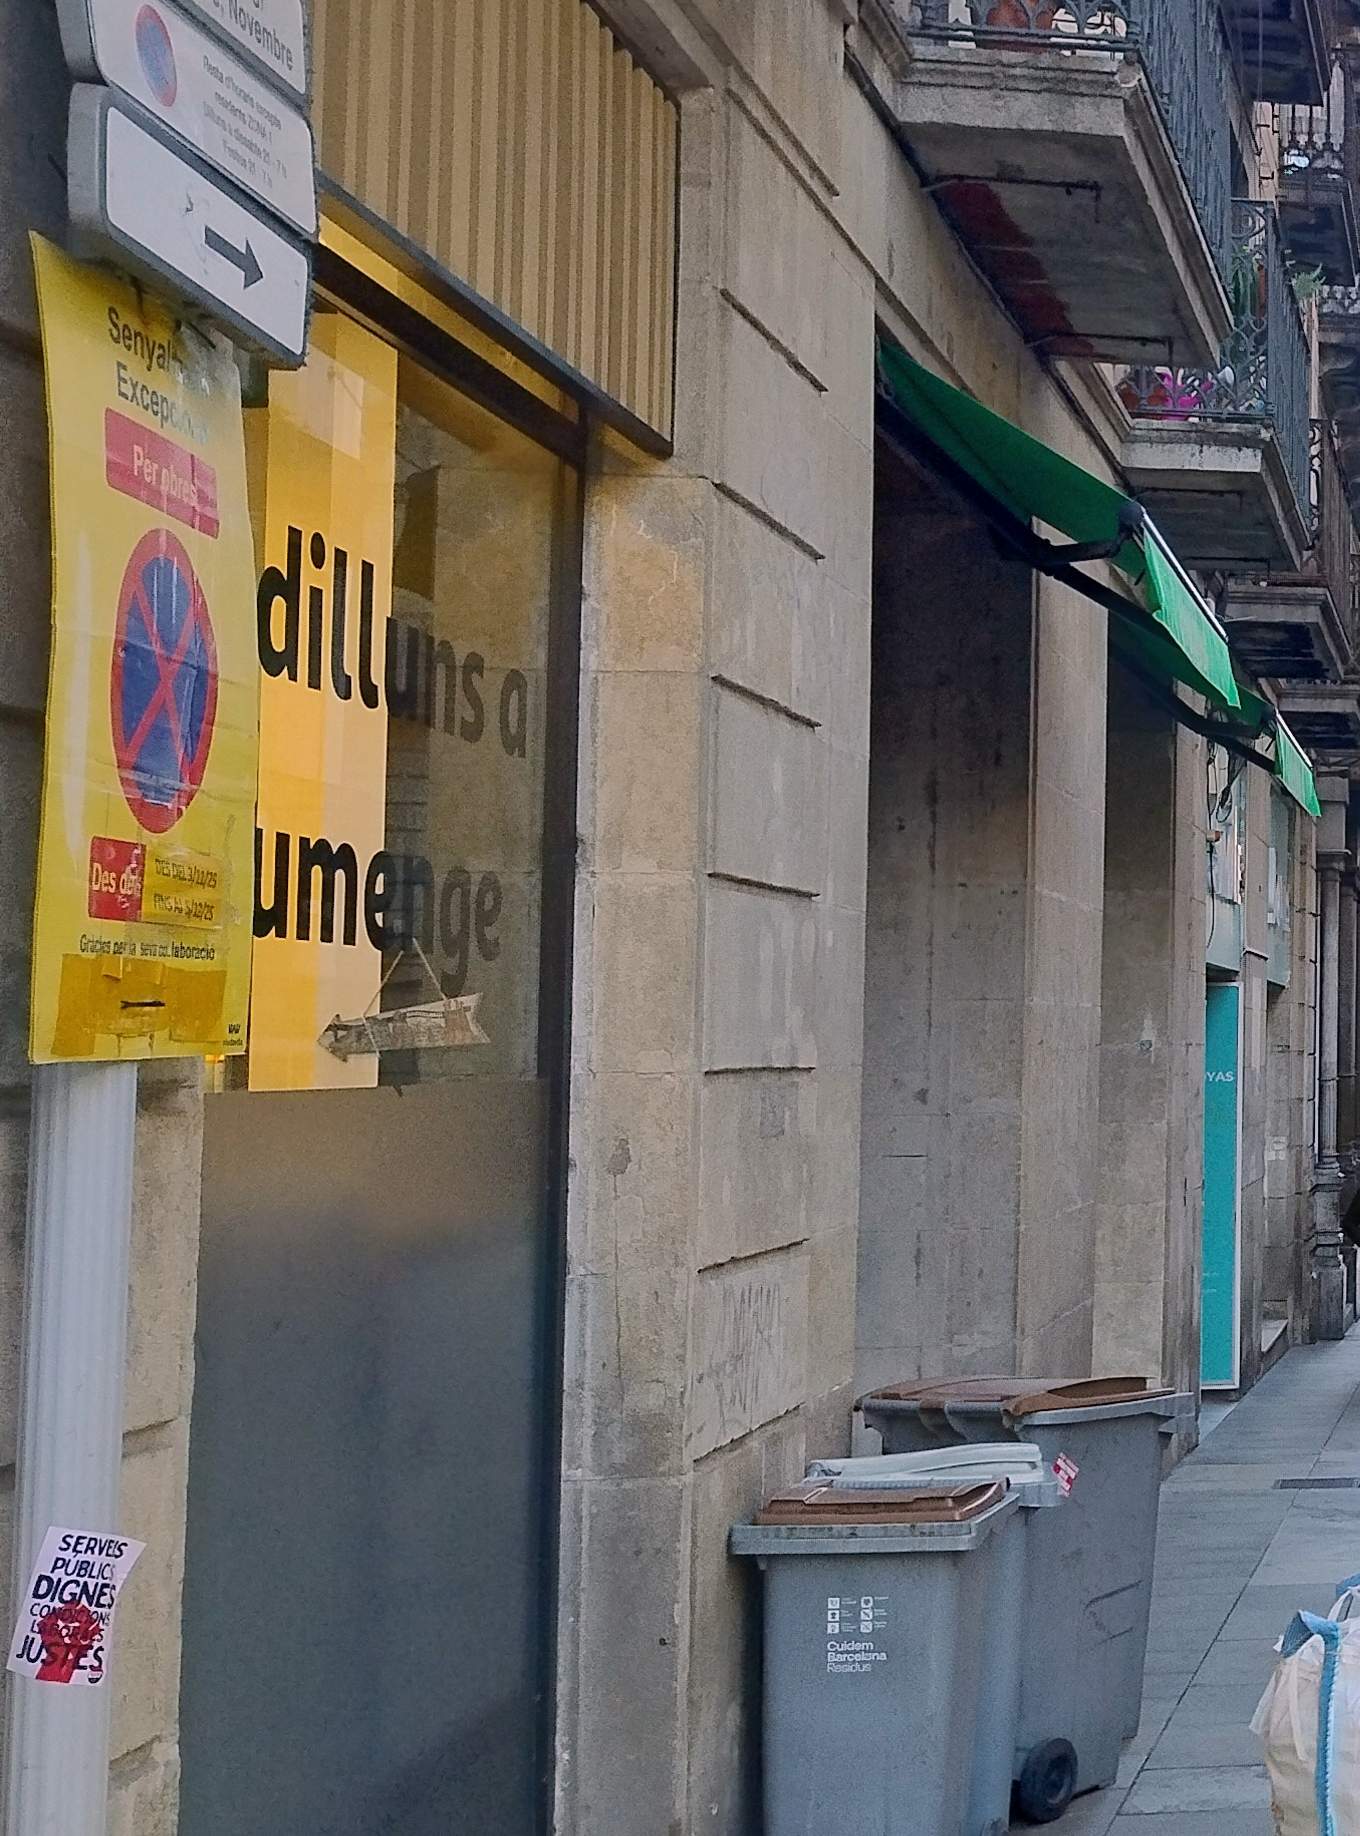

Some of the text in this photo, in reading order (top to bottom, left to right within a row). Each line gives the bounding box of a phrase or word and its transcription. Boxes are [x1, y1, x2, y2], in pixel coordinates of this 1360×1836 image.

[228, 0, 293, 71] Novembre
[133, 444, 198, 506] Per obres
[257, 525, 528, 758] dilluns a
[91, 862, 116, 893] Des
[253, 826, 502, 995] umenge
[1206, 1070, 1234, 1082] YAS
[58, 1534, 128, 1559] SERVEIS
[32, 1574, 116, 1609] DIGNES
[29, 1602, 111, 1627] CONONS
[16, 1635, 105, 1671] JUES
[827, 1641, 874, 1651] Cuidem
[827, 1651, 888, 1662] Barcelona
